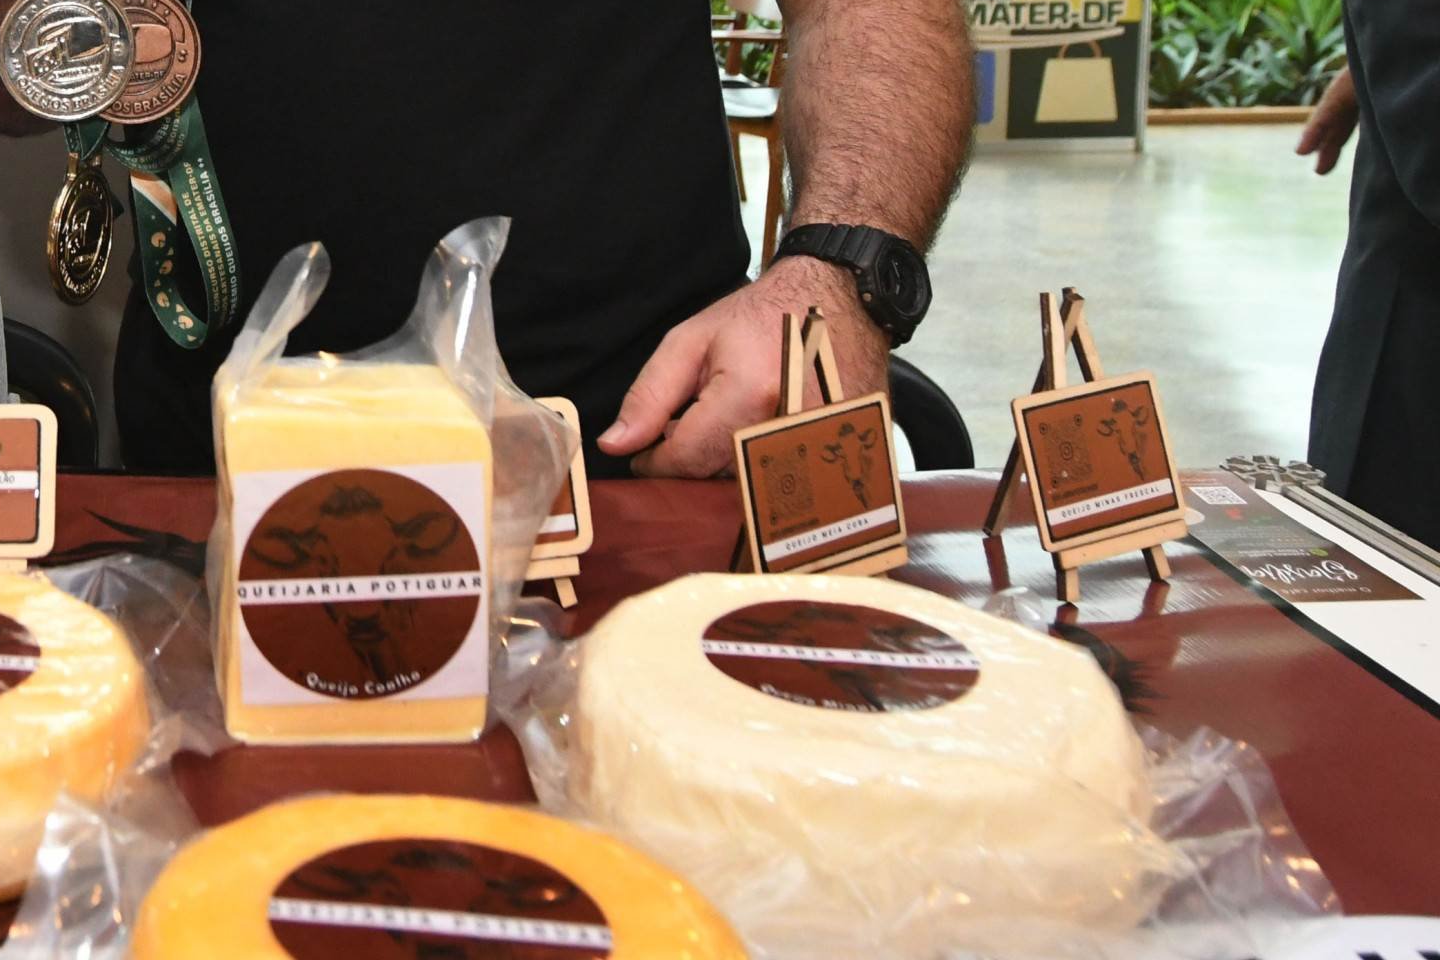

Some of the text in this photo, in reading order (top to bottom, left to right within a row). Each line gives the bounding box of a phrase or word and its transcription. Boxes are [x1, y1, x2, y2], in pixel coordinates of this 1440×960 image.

[971, 0, 1125, 26] MATER-DF
[134, 72, 186, 113] BRASÍLIA
[181, 191, 192, 207] DE
[199, 170, 224, 226] BRASÍLIA
[188, 207, 210, 258] DISTRITAL
[203, 218, 214, 233] DA
[217, 226, 236, 274] QUEIJOS
[237, 576, 483, 600] QUEIJARIA POTIGUAR
[305, 670, 421, 698] Queijo Coalho
